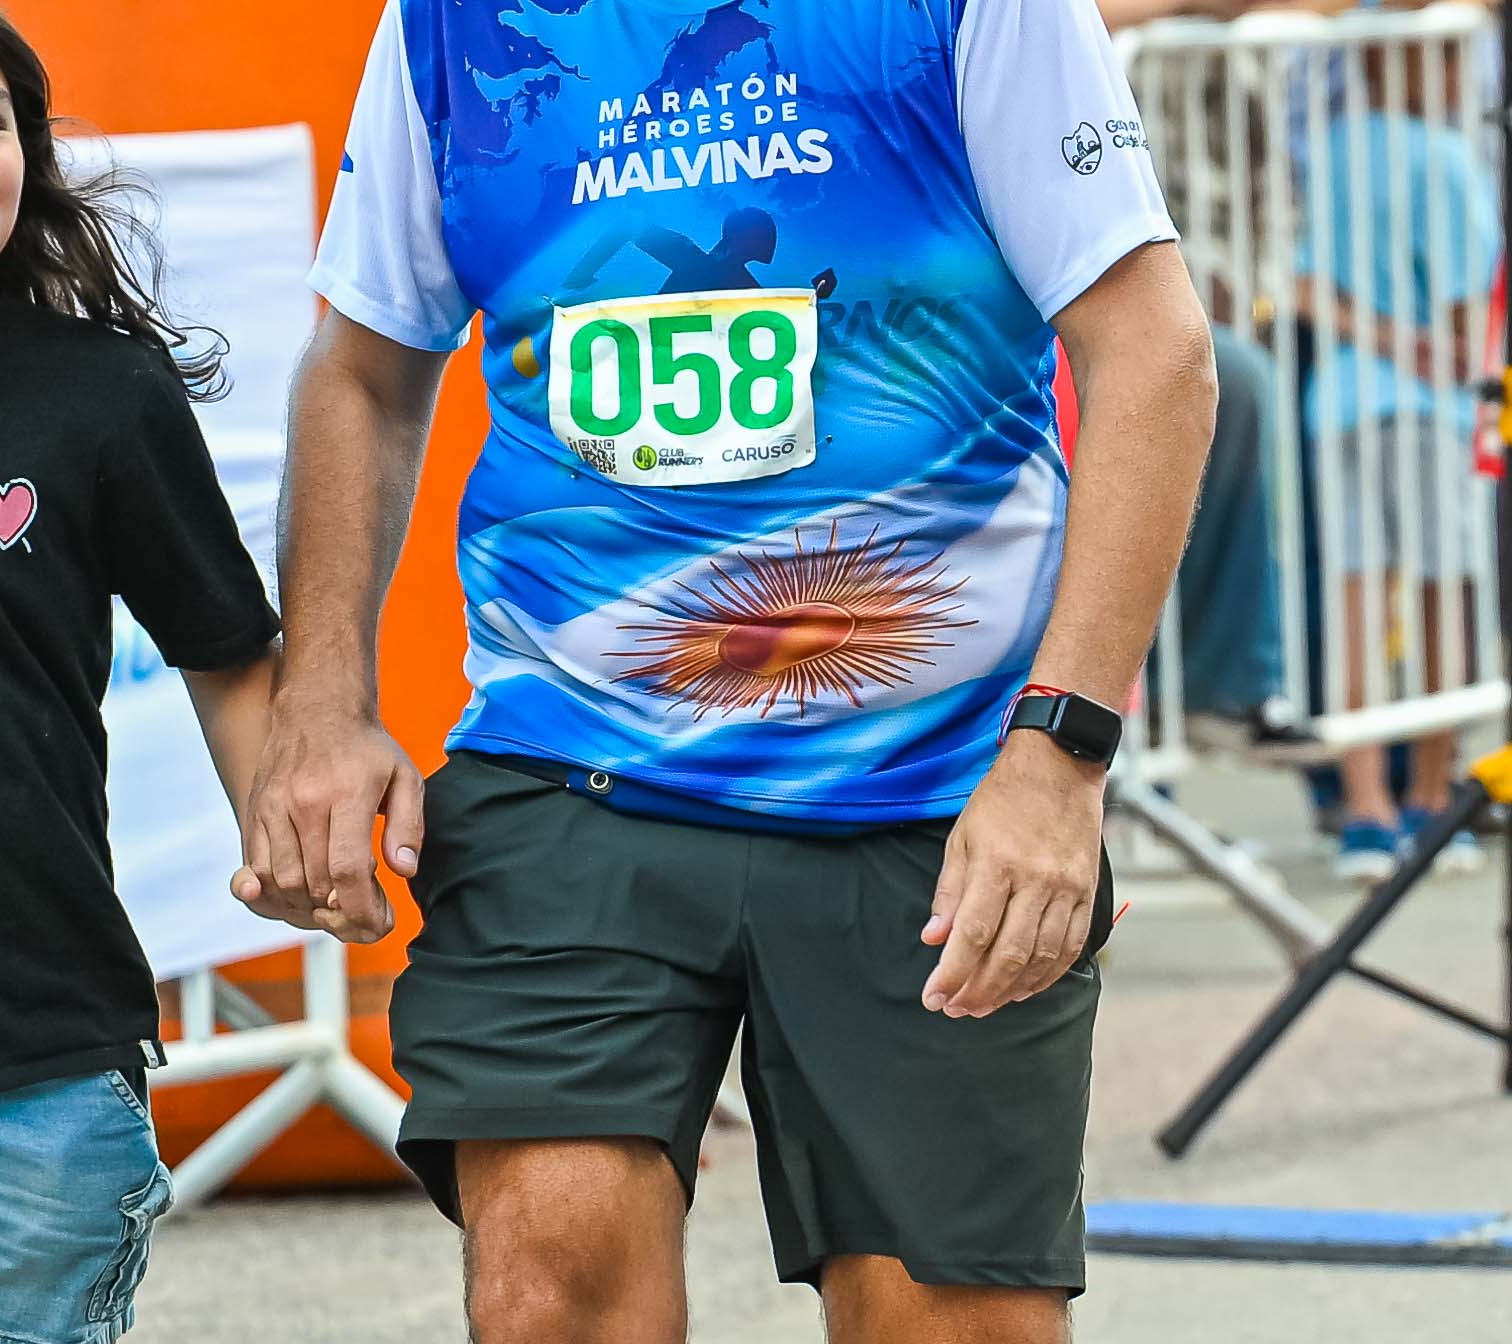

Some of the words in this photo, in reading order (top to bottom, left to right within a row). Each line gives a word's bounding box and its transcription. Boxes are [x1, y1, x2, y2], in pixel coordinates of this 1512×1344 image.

[597, 72, 798, 123] MARATÓN
[597, 111, 735, 148] HÉROES
[754, 102, 798, 126] DE
[571, 128, 833, 205] MALVINAS
[570, 311, 796, 436] 058
[658, 448, 685, 457] CLUB
[721, 442, 795, 463] CARUSO
